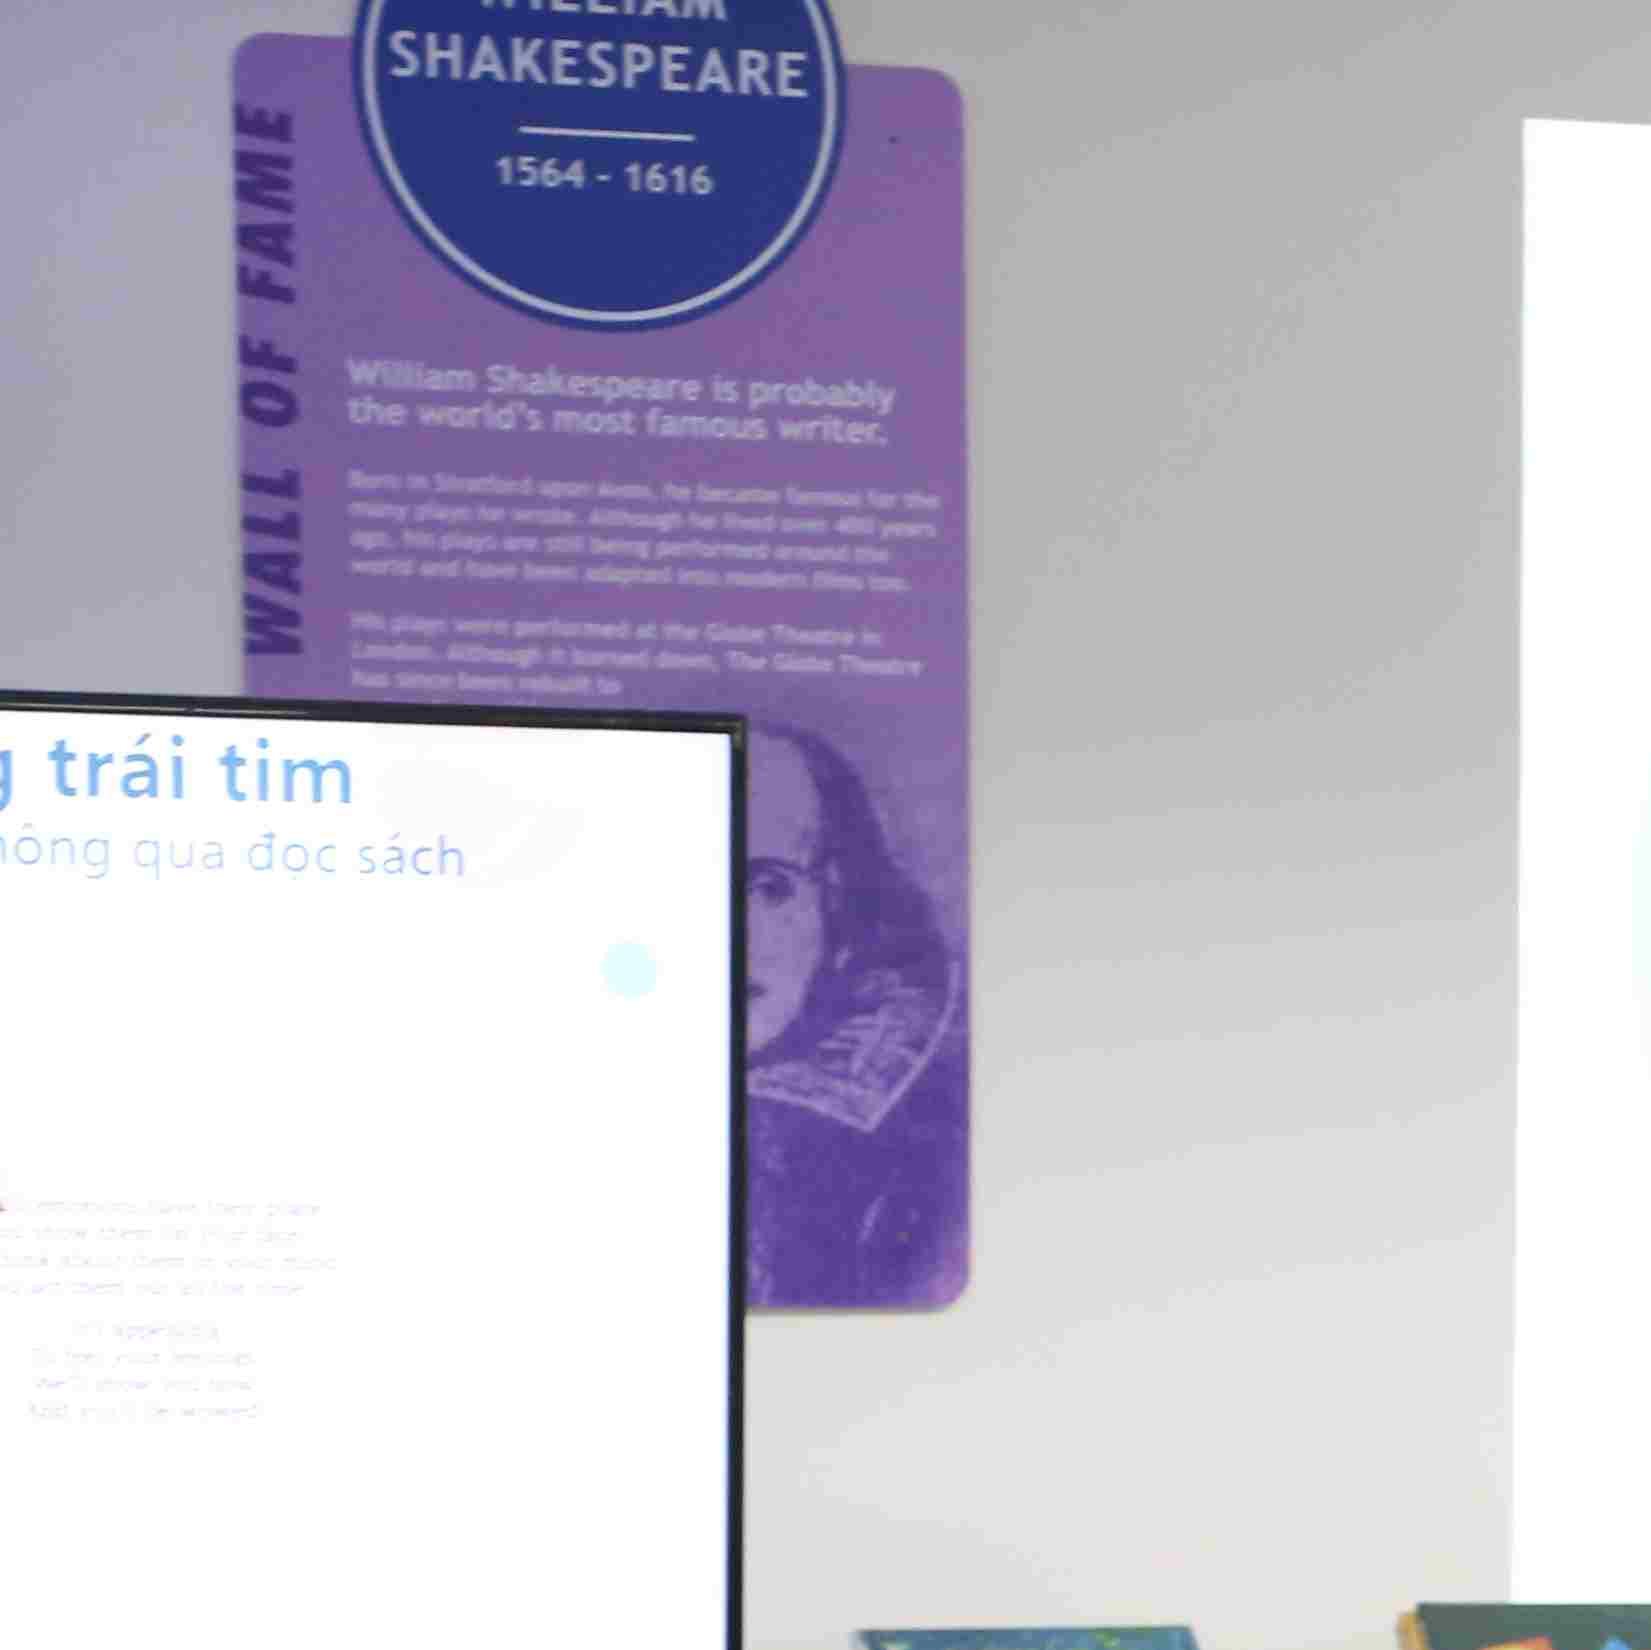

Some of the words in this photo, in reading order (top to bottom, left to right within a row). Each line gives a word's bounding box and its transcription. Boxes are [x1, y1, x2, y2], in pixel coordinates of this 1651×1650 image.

[389, 30, 808, 98] SHAKESPEARE
[235, 103, 297, 303] FAME
[496, 156, 585, 189] 1564
[626, 162, 715, 195] 1616
[238, 333, 299, 428] OF
[346, 357, 476, 392] William
[486, 364, 701, 405] Shakespeare
[712, 373, 738, 403] is
[749, 376, 896, 416] probably
[346, 396, 406, 428] the
[416, 398, 544, 432] world's
[553, 407, 637, 437] most
[646, 406, 768, 441] famous
[241, 467, 302, 656] WALL
[48, 732, 185, 799] trái
[218, 736, 352, 804] tim
[132, 834, 227, 880] qua
[247, 831, 337, 880] đọc
[357, 832, 466, 877] sách
